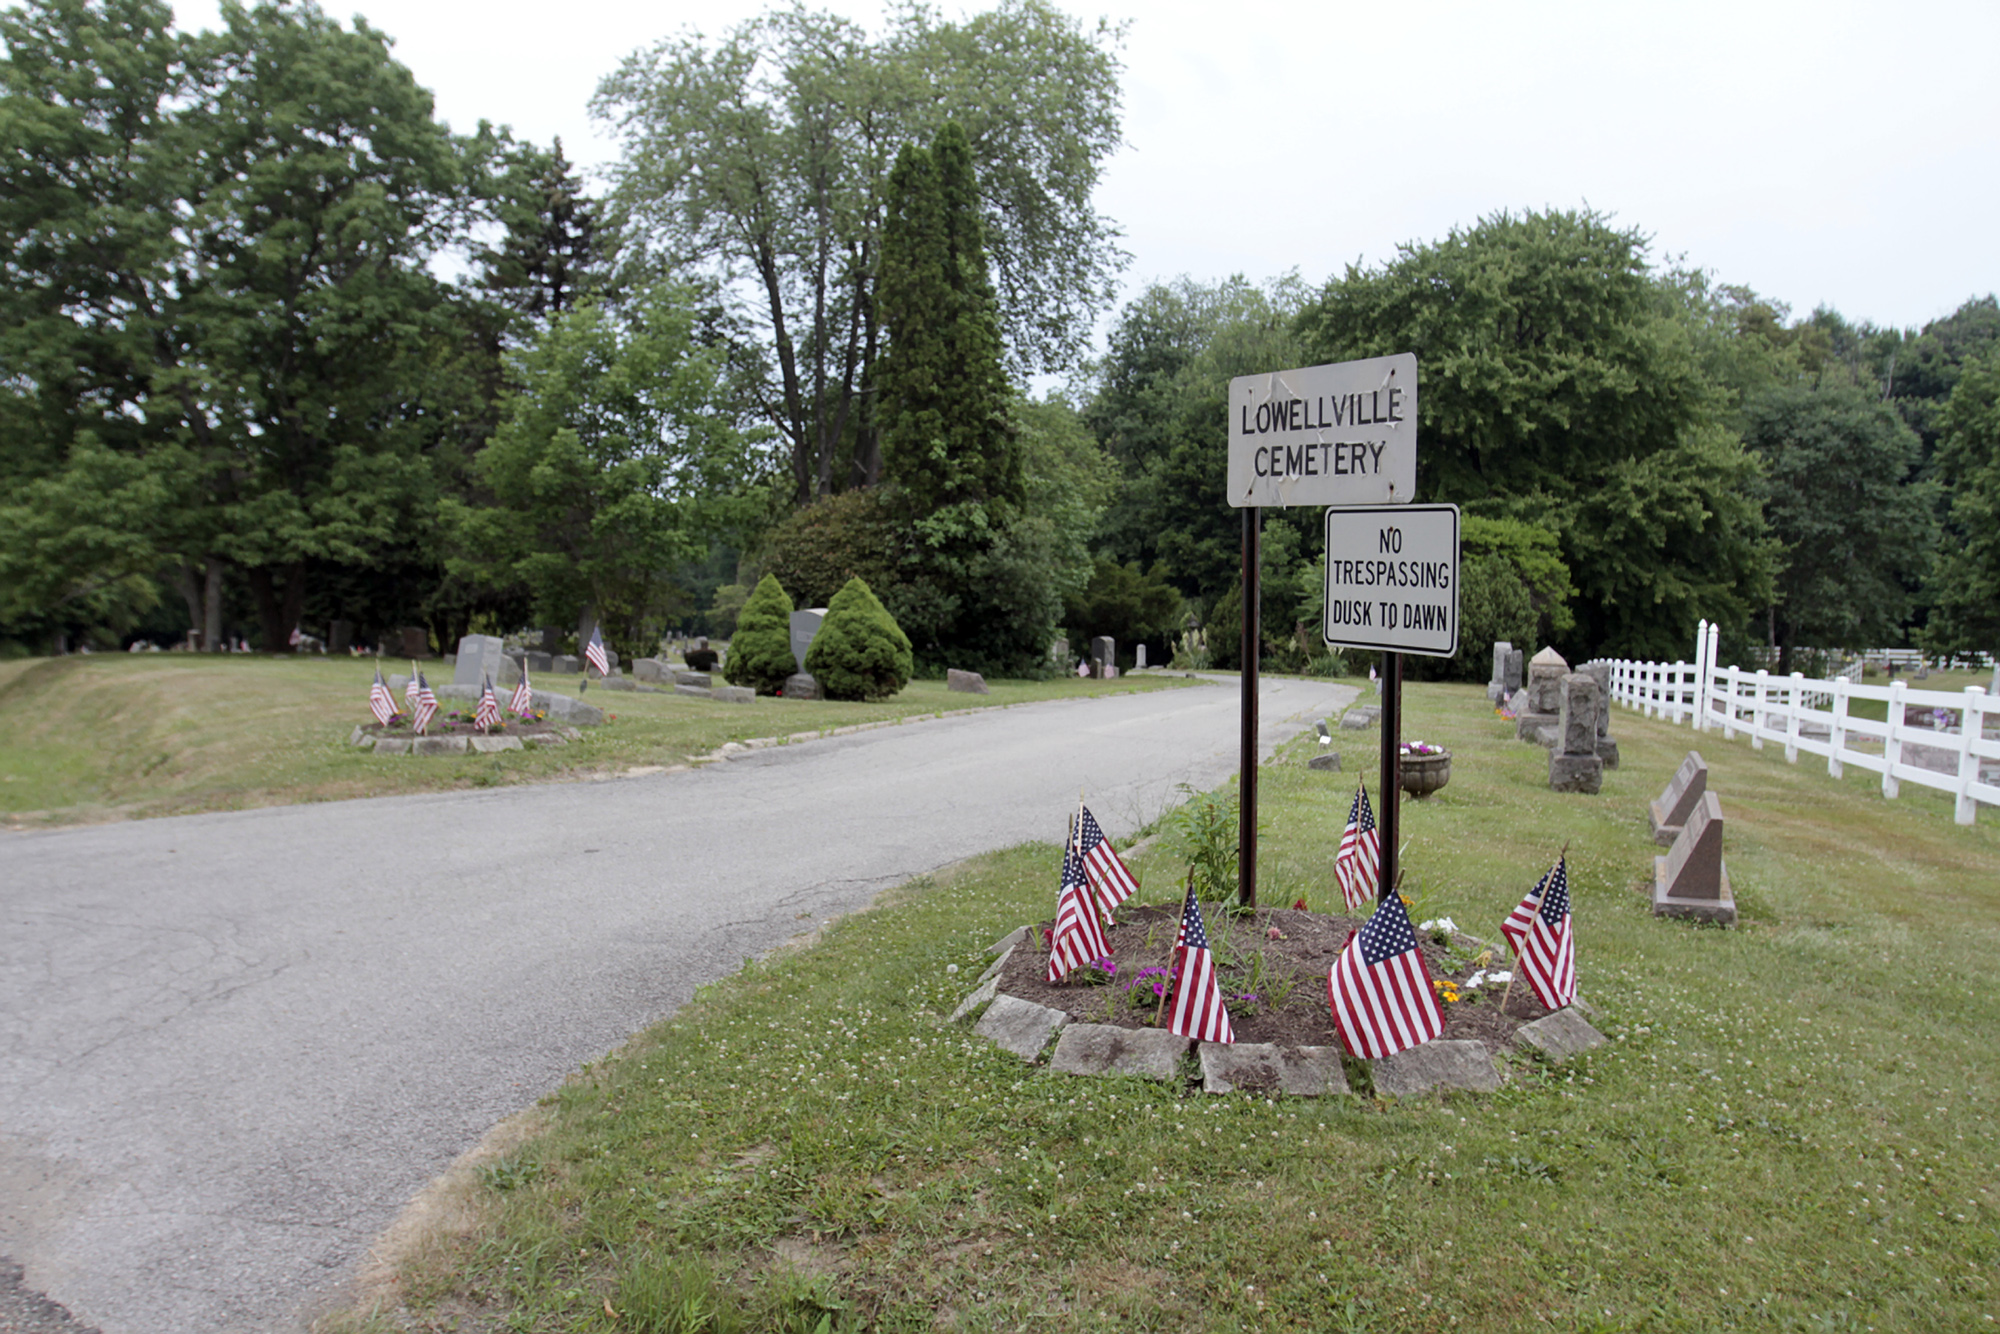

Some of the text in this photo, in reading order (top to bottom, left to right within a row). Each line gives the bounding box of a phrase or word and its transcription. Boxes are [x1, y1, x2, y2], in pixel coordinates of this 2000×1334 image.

[1242, 388, 1403, 435] LOWELLVILLE
[1254, 440, 1386, 477] CEMETERY
[1380, 528, 1402, 554] NO
[1334, 560, 1449, 589] TRESPASSING
[1333, 600, 1447, 632] DUSK TO DAWN
